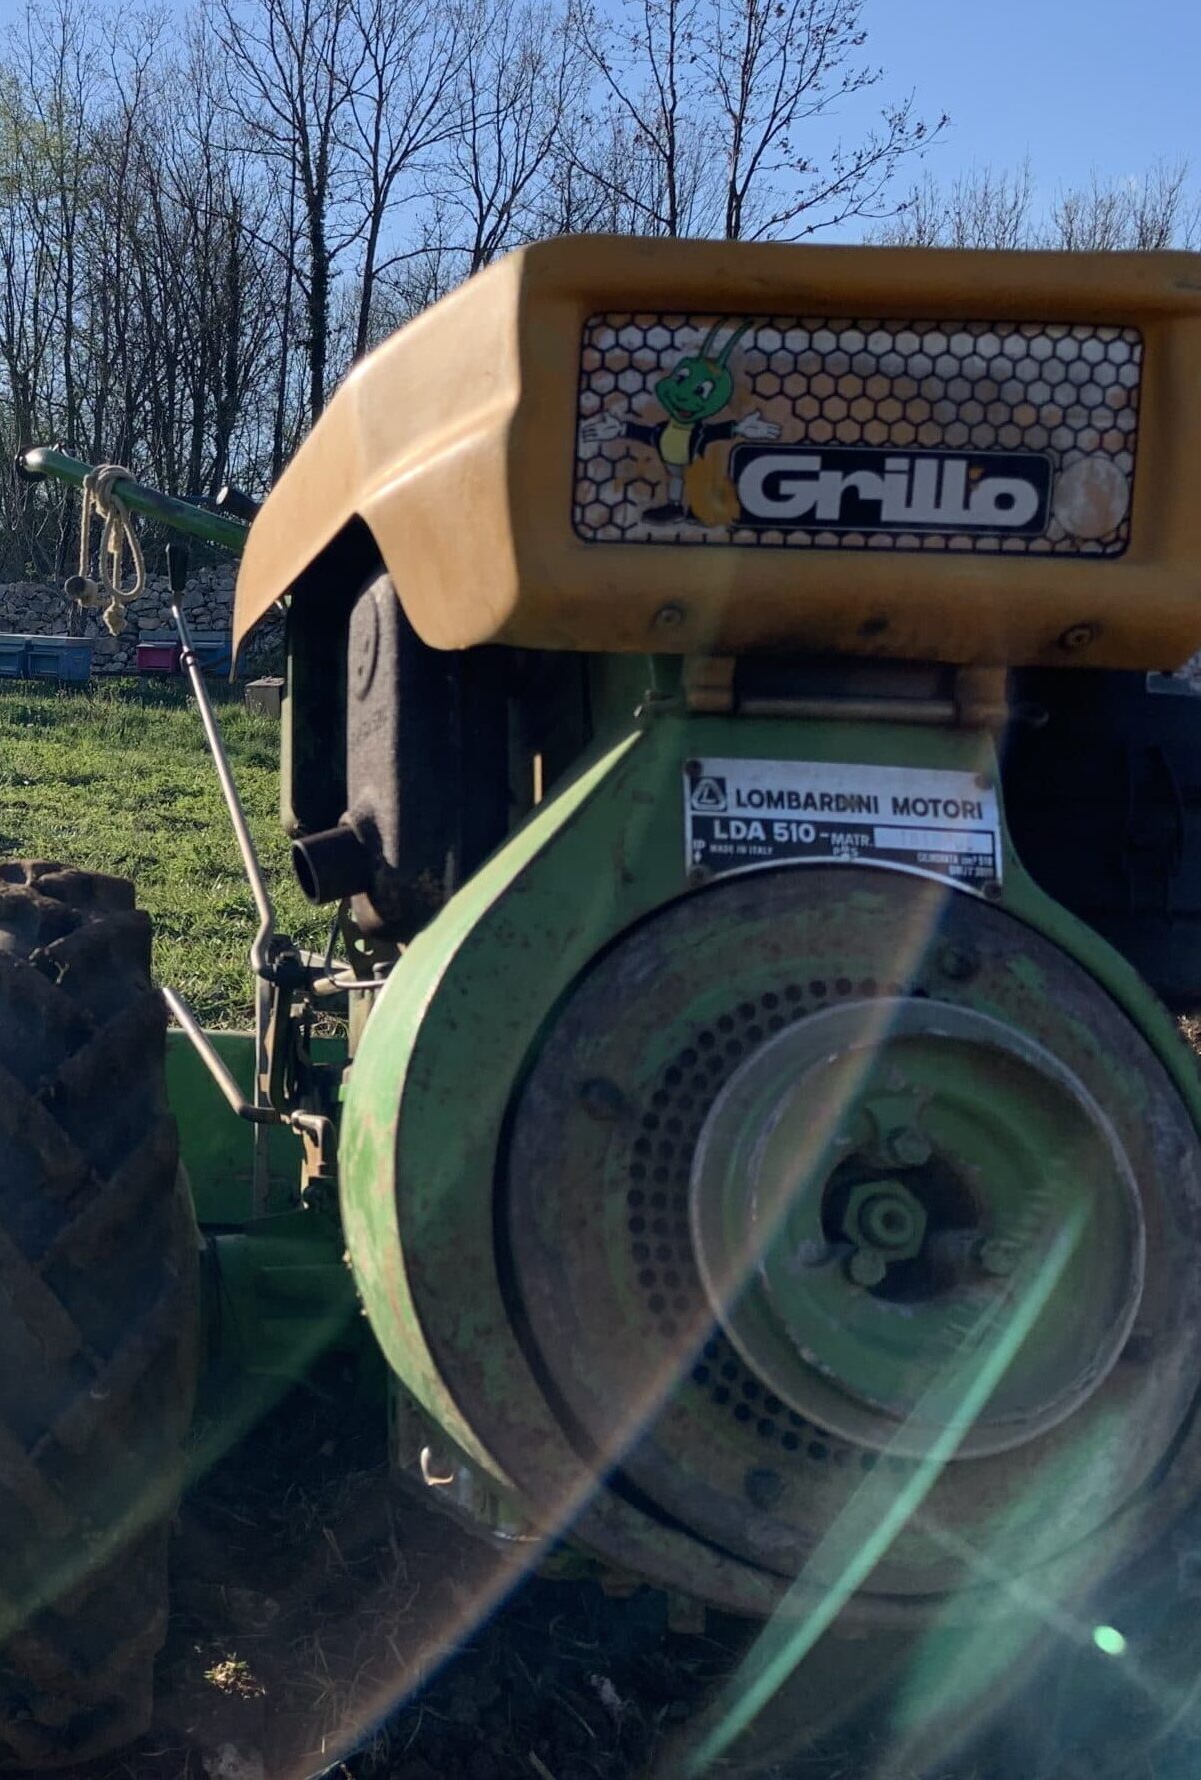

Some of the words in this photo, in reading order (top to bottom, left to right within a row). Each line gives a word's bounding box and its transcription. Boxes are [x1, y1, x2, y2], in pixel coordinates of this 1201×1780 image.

[738, 454, 1039, 527] Grillo
[736, 788, 879, 815] LOMBARDINI
[892, 796, 983, 820] MOTORI
[713, 819, 766, 841] LDA
[773, 821, 816, 843] 510
